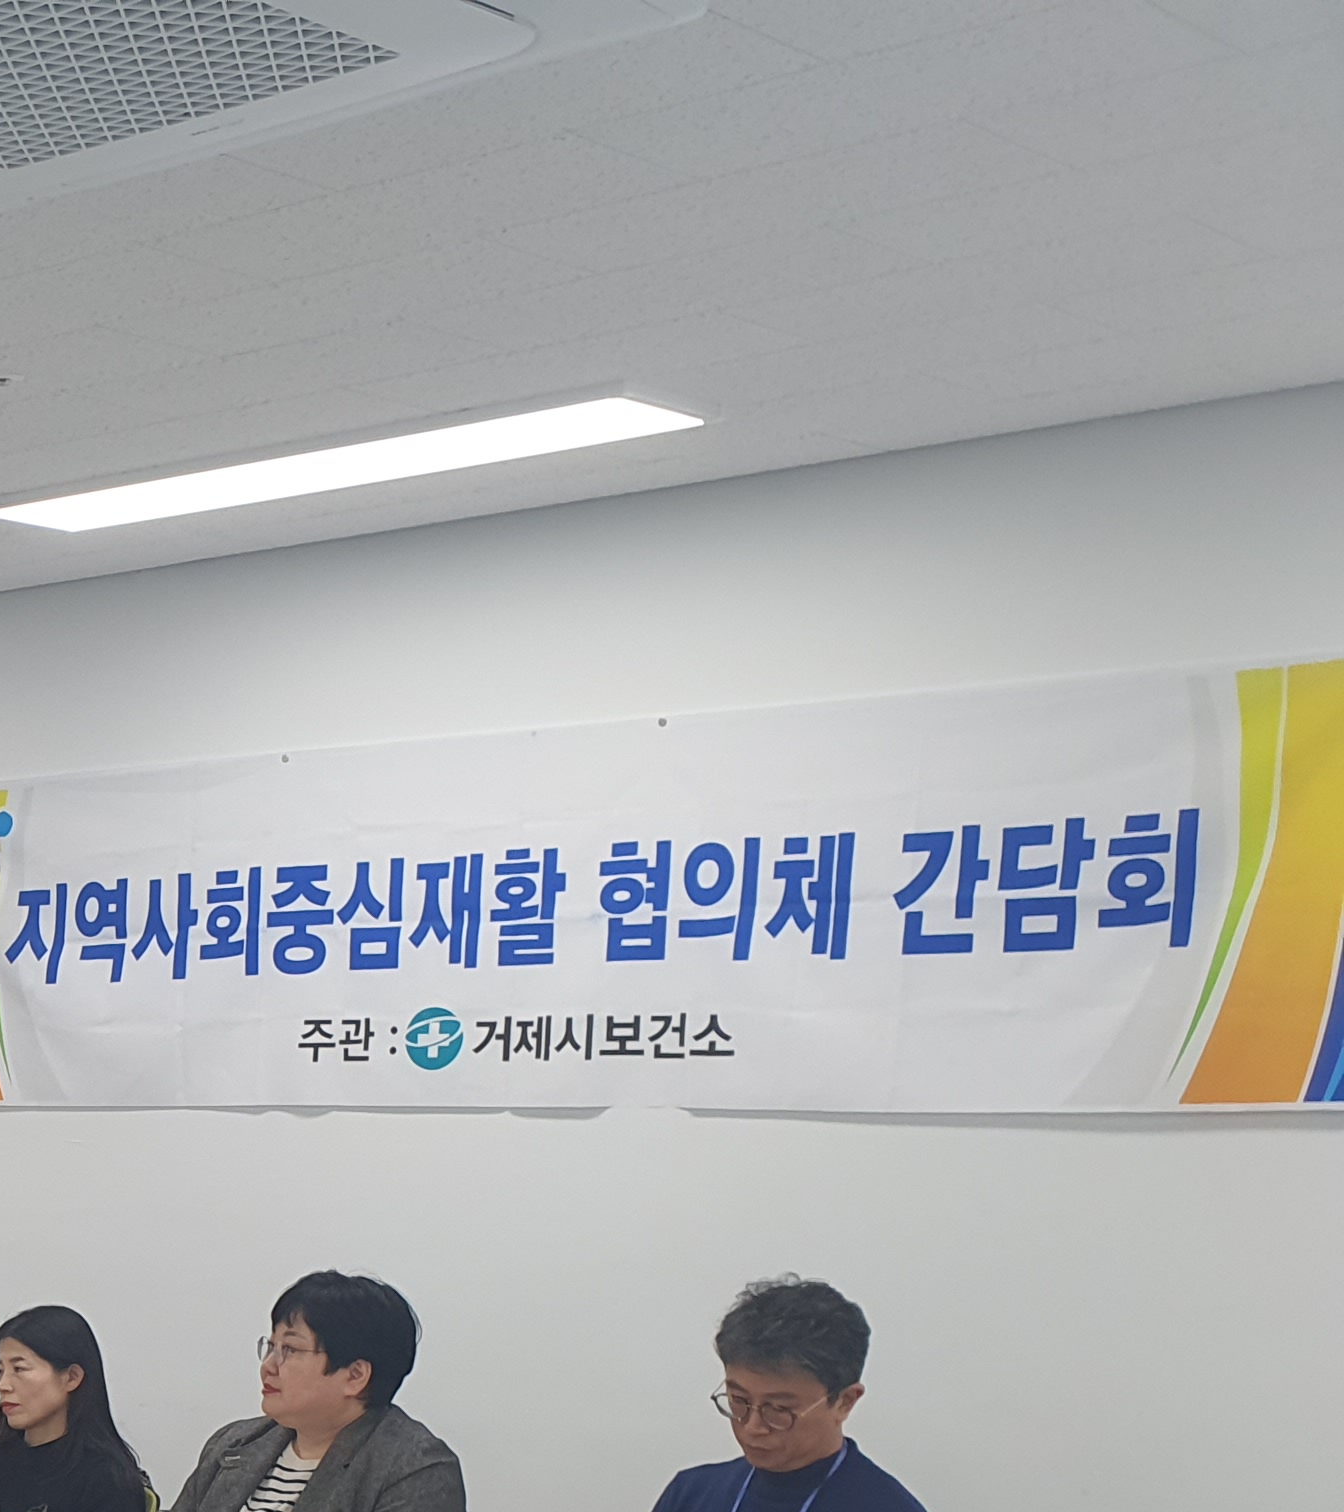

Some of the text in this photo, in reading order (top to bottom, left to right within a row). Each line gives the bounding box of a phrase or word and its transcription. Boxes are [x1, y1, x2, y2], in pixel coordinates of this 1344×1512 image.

[4, 808, 1199, 984] 지역사회중심재활 협의체 간담회
[297, 1016, 375, 1063] 주관
[472, 1012, 735, 1062] 거제시보건소
